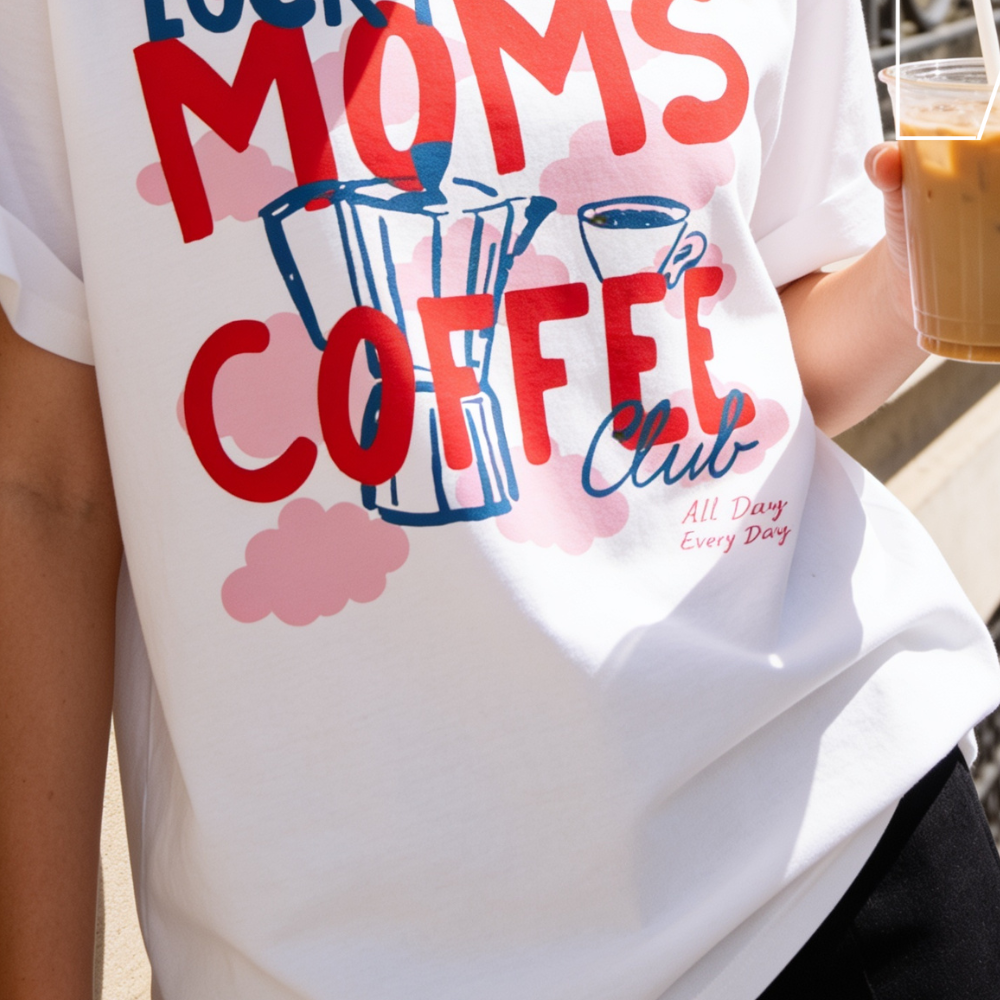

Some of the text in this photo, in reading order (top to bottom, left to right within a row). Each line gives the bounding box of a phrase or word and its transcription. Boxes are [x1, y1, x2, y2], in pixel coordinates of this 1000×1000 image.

[184, 266, 756, 502] COFFEE
[582, 389, 759, 498] Club
[681, 525, 792, 553] Every Day
[682, 497, 718, 524] All
